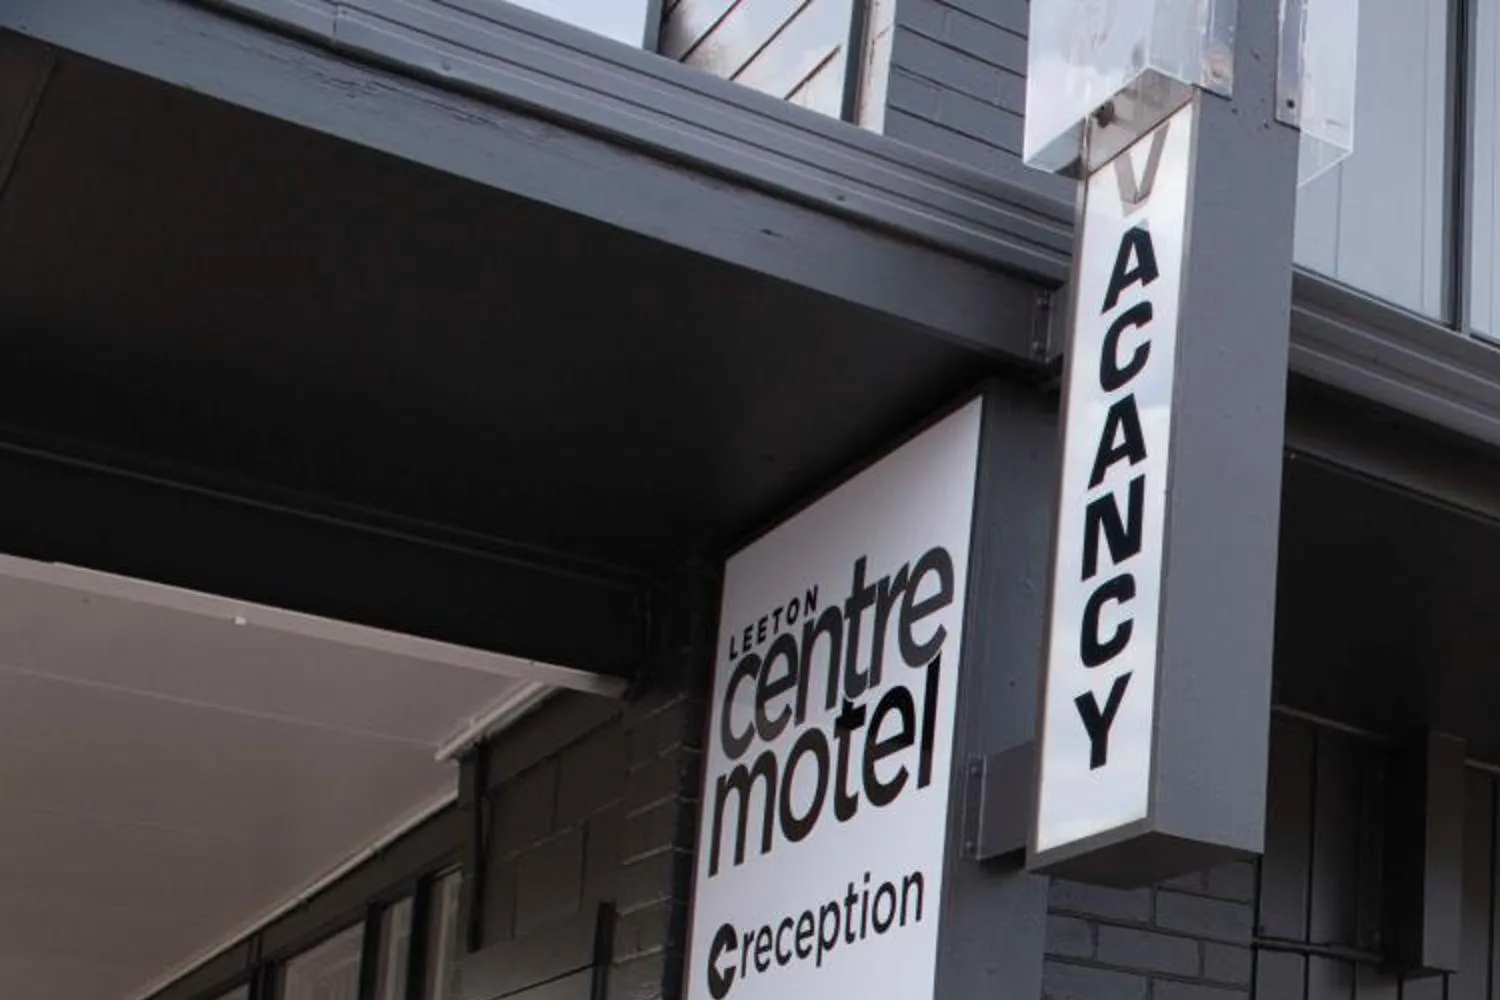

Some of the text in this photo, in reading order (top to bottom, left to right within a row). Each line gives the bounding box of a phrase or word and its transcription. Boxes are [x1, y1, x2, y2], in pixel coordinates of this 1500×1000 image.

[1073, 118, 1170, 771] VACANCY
[720, 545, 955, 760] centre
[728, 583, 819, 661] LEETON
[708, 649, 943, 879] motel
